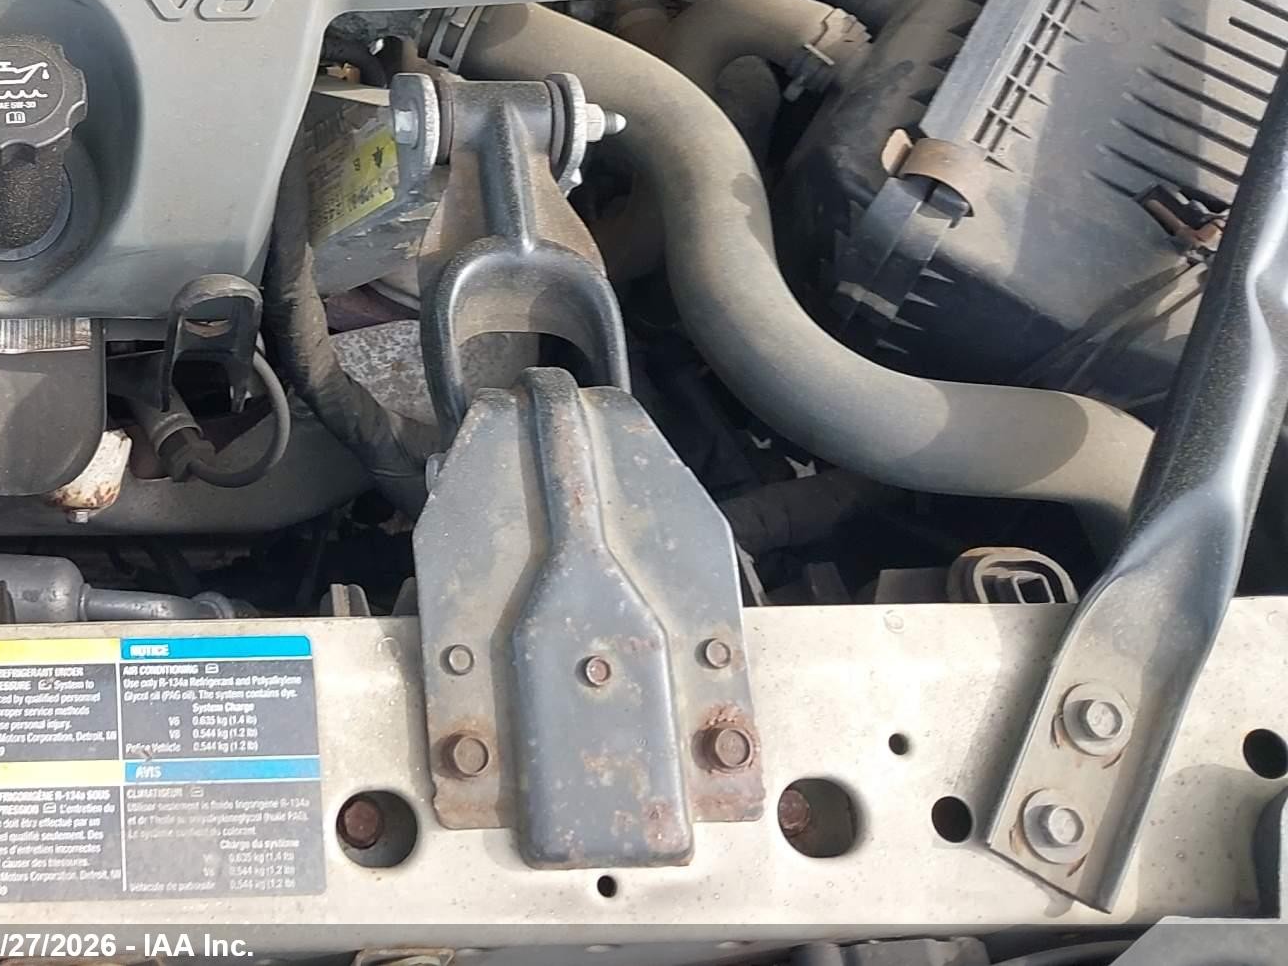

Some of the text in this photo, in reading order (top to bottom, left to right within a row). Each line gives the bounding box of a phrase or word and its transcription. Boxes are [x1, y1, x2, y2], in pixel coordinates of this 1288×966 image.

[10, 100, 37, 110] 5W-30
[130, 643, 169, 656] NOTICE
[122, 664, 199, 676] AIR CONDITIONING
[54, 680, 85, 692] System
[85, 679, 95, 690] to
[123, 676, 251, 690] Use only R-134a Refrigerant and
[13, 694, 24, 706] by
[60, 692, 101, 704] personnel
[198, 690, 214, 700] The
[215, 689, 244, 700] system
[245, 689, 280, 699] contains
[24, 707, 54, 717] service
[54, 706, 90, 716] methods
[192, 702, 255, 714] System Charge
[216, 715, 228, 726] kg
[228, 714, 245, 725] (1.4
[10, 721, 46, 732] personal
[192, 728, 216, 738] 0.544
[217, 728, 229, 740] kg
[229, 727, 245, 738] (1.2
[192, 741, 217, 751] 0.544
[217, 740, 229, 753] kg
[229, 740, 246, 752] (1.2
[135, 765, 162, 779] AVIS
[103, 803, 115, 813] du
[73, 818, 88, 829] par
[219, 839, 251, 850] Charge
[0, 872, 30, 882] Motors
